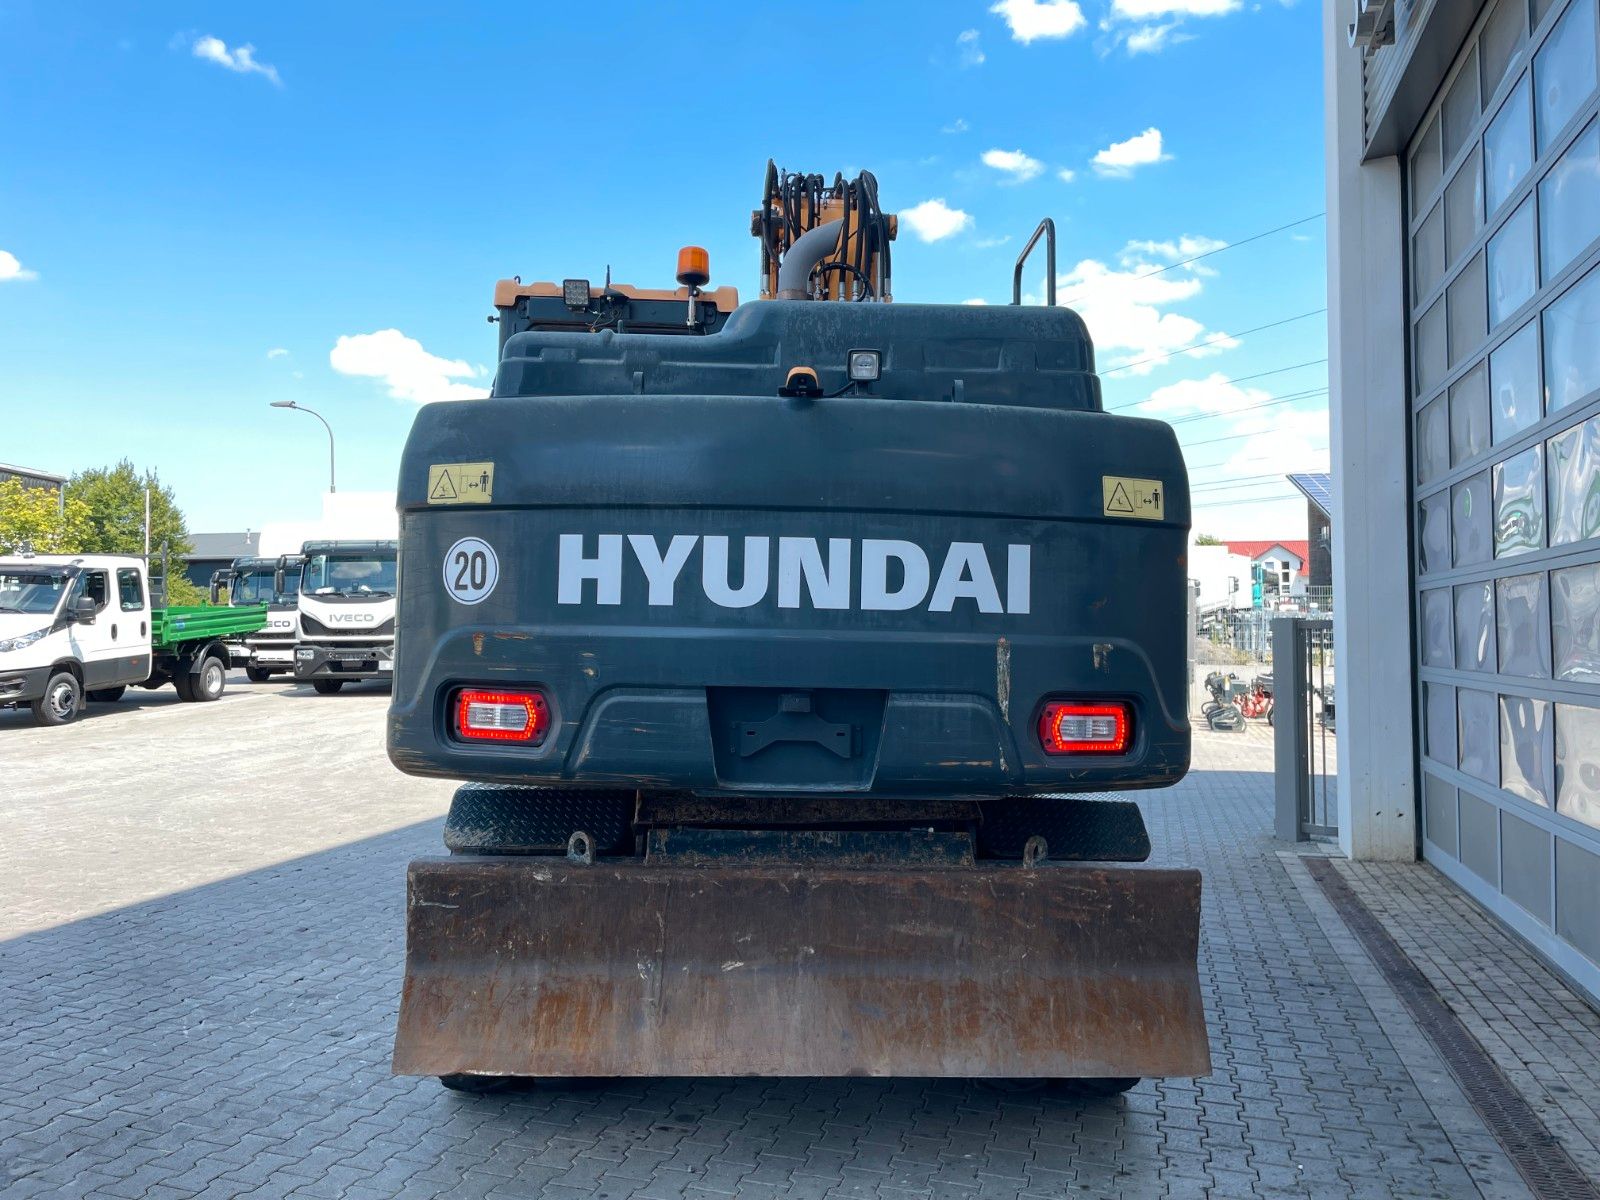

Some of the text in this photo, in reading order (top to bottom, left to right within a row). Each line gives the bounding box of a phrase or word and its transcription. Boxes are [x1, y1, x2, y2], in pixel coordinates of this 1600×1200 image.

[454, 550, 487, 591] 20
[557, 533, 1031, 615] HYUNDAI
[266, 620, 291, 628] ECO
[329, 613, 374, 622] IVECO
